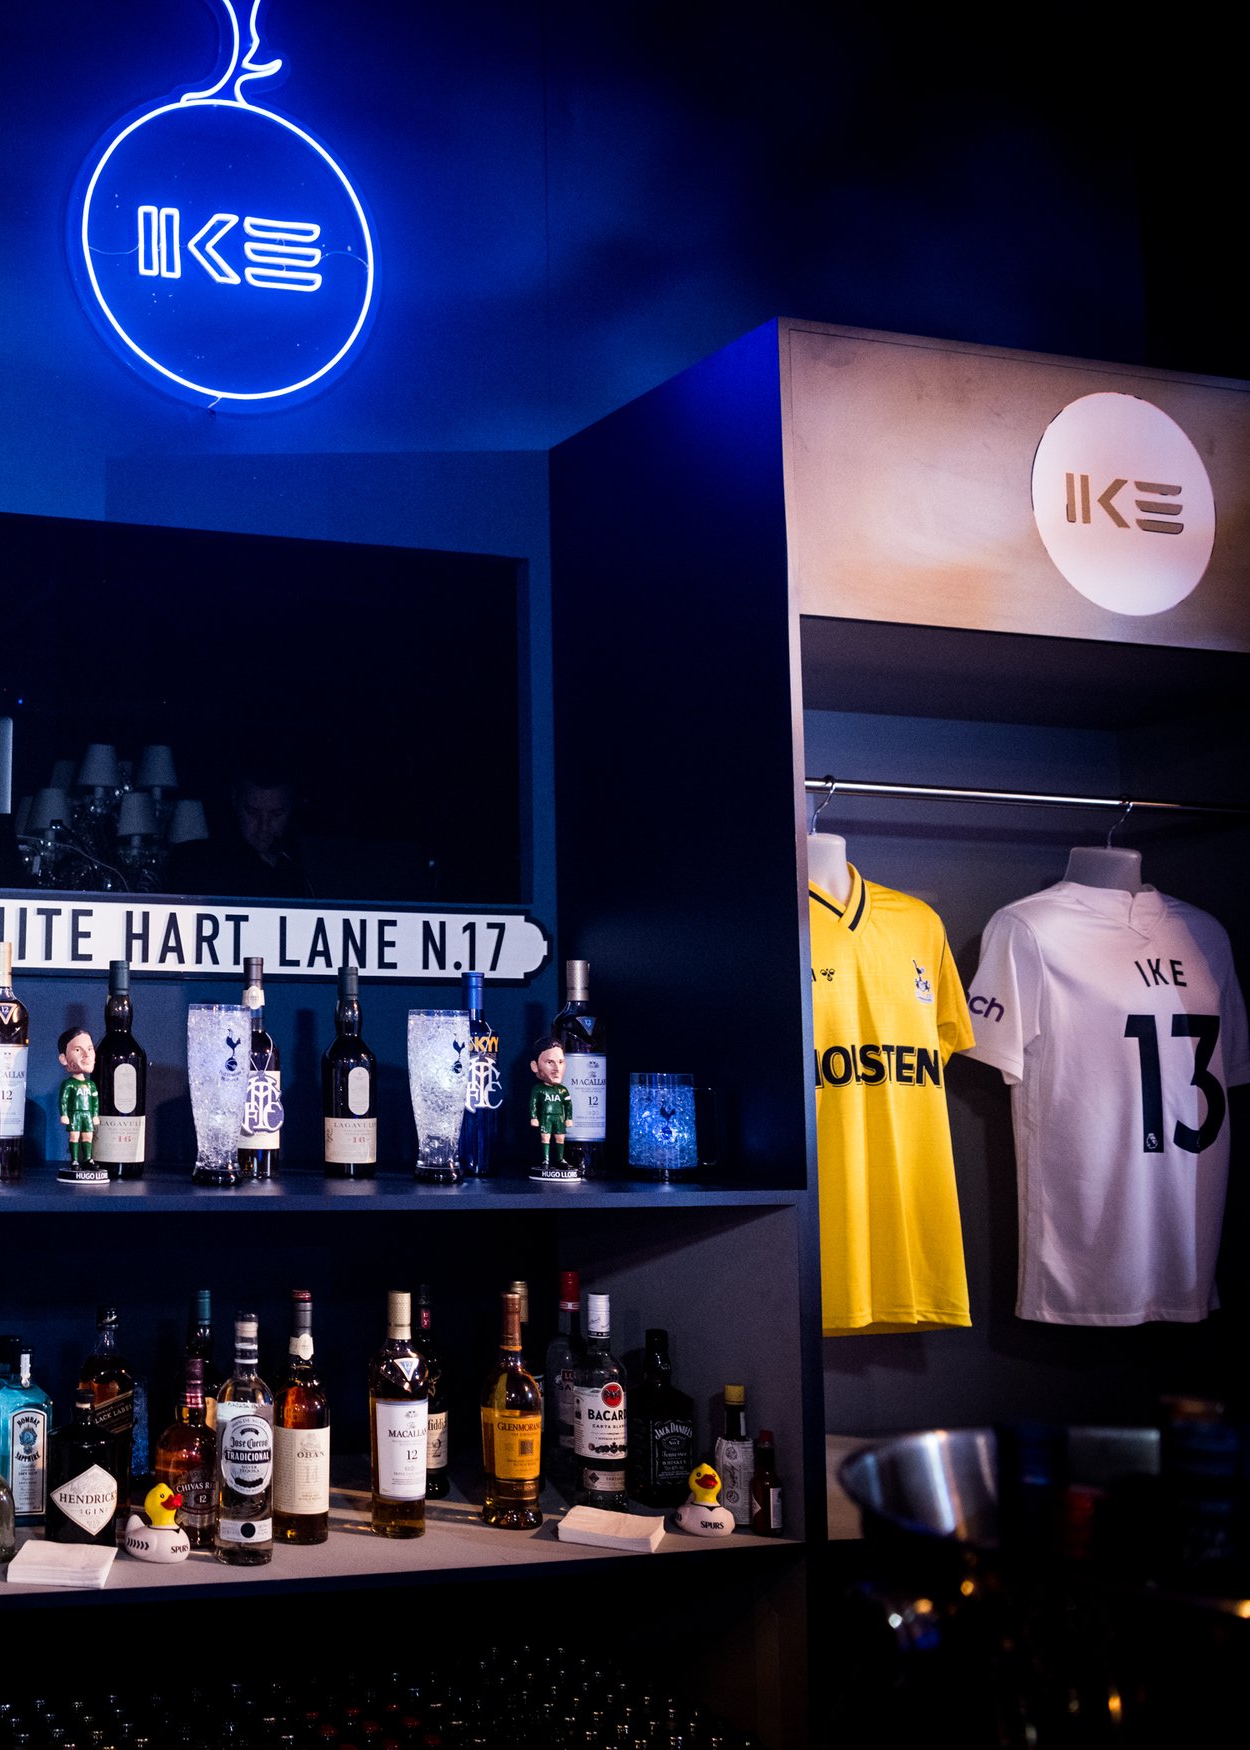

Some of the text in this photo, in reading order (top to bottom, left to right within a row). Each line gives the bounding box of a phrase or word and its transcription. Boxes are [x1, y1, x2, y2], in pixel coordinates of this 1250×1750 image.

[137, 205, 323, 292] IKE
[1065, 472, 1184, 535] IKE
[125, 911, 249, 965] HART
[279, 915, 398, 969] LANE
[422, 920, 506, 971] N.17
[1135, 958, 1187, 987] IKE
[1124, 1013, 1226, 1154] 13
[1, 1090, 13, 1100] 12
[544, 1093, 561, 1102] AIA
[587, 1095, 599, 1106] 12
[75, 1172, 95, 1180] HUGO
[654, 1425, 671, 1440] JACK
[226, 1451, 269, 1462] TRADICIONAL
[406, 1449, 418, 1460] 12
[176, 1482, 204, 1493] CHIVAS
[199, 1495, 207, 1503] 12
[85, 1508, 104, 1516] GIN
[700, 1520, 724, 1530] SPURS
[171, 1545, 189, 1554] SPURS
